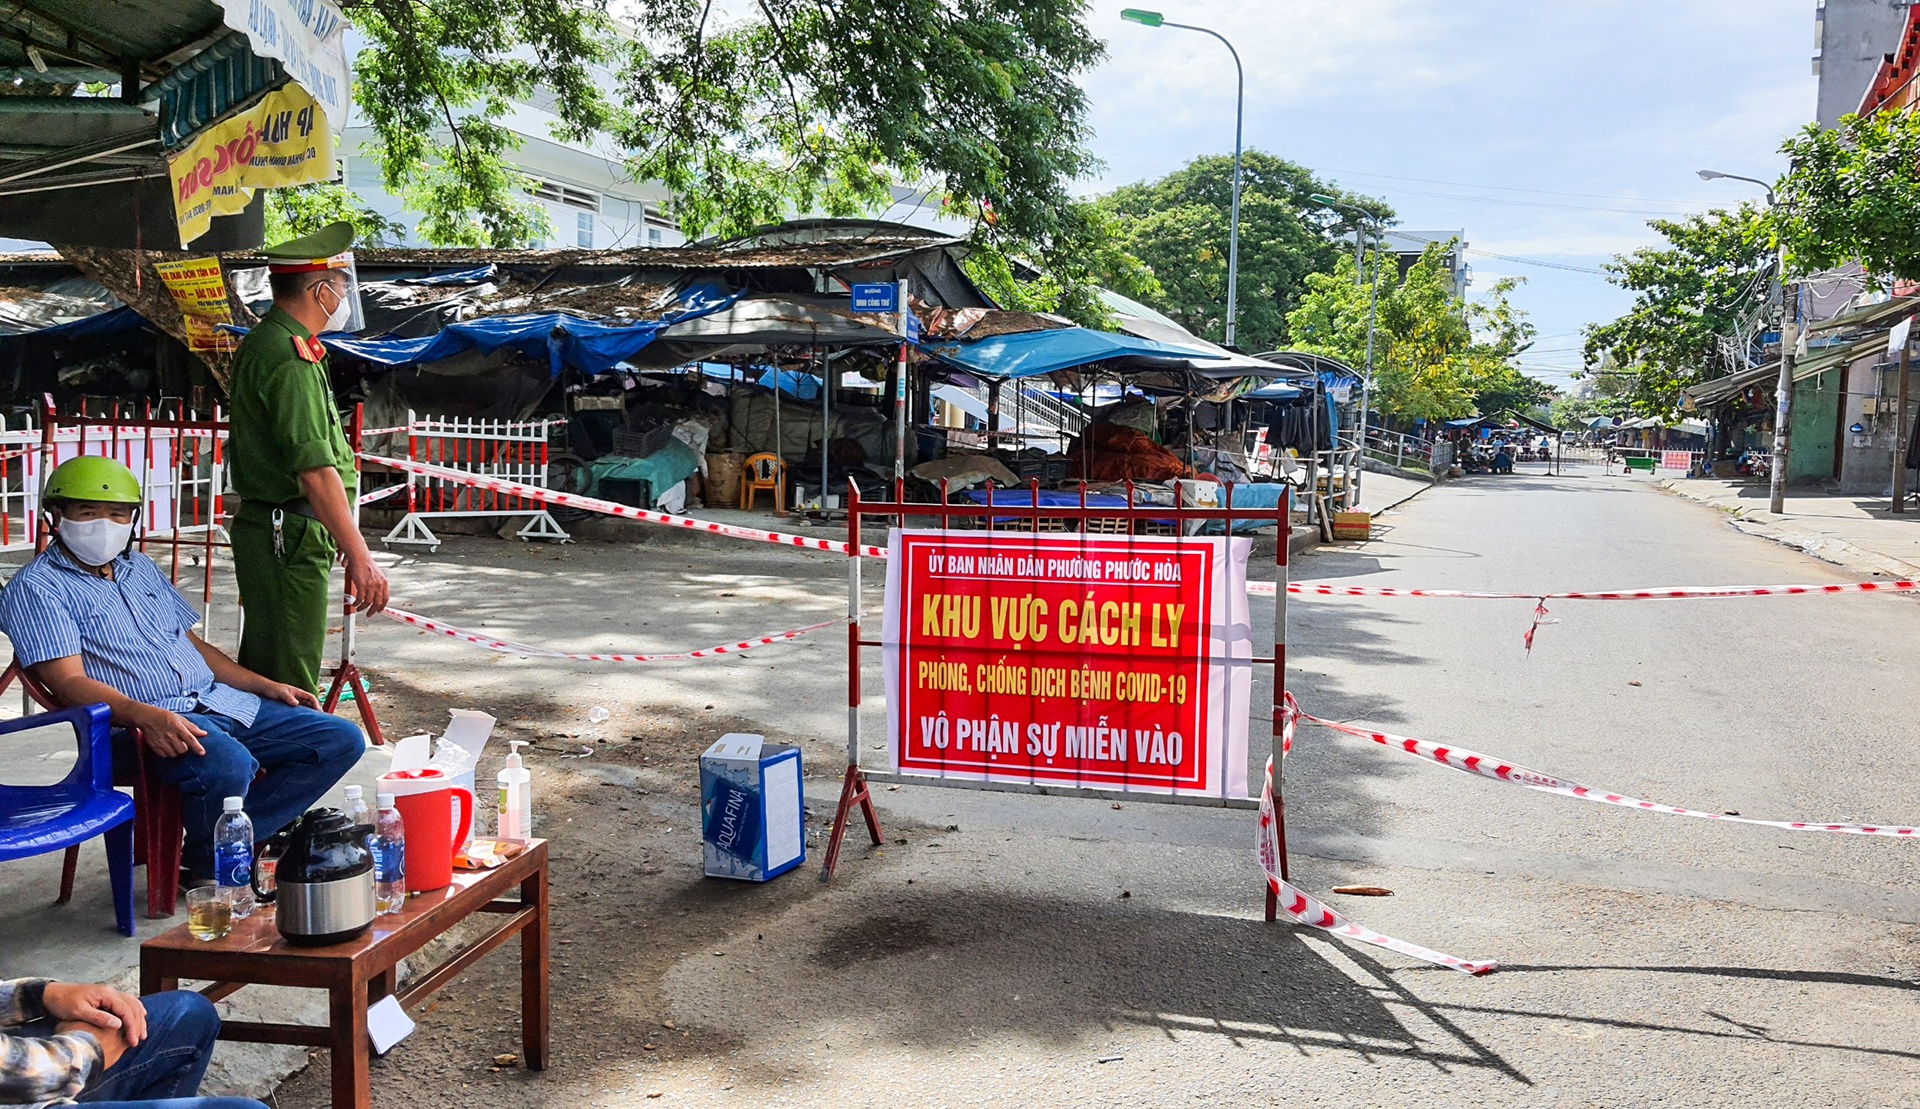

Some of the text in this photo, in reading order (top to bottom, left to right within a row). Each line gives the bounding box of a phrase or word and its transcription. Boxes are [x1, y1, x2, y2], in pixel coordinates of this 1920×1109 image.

[928, 549, 1182, 582] ỦY BAN NHÂN DÂN PHƯỜNG PHƯỚC HÒA
[921, 591, 1186, 650] KHU VỰC CÁCH LY
[918, 655, 1187, 705] PHÒNG, CHỐNG DỊCH BỆNH COVID-19
[920, 710, 1183, 766] VÔ PHẬN SỰ MIỄN VÀO
[716, 789, 748, 854] AQUAFINA
